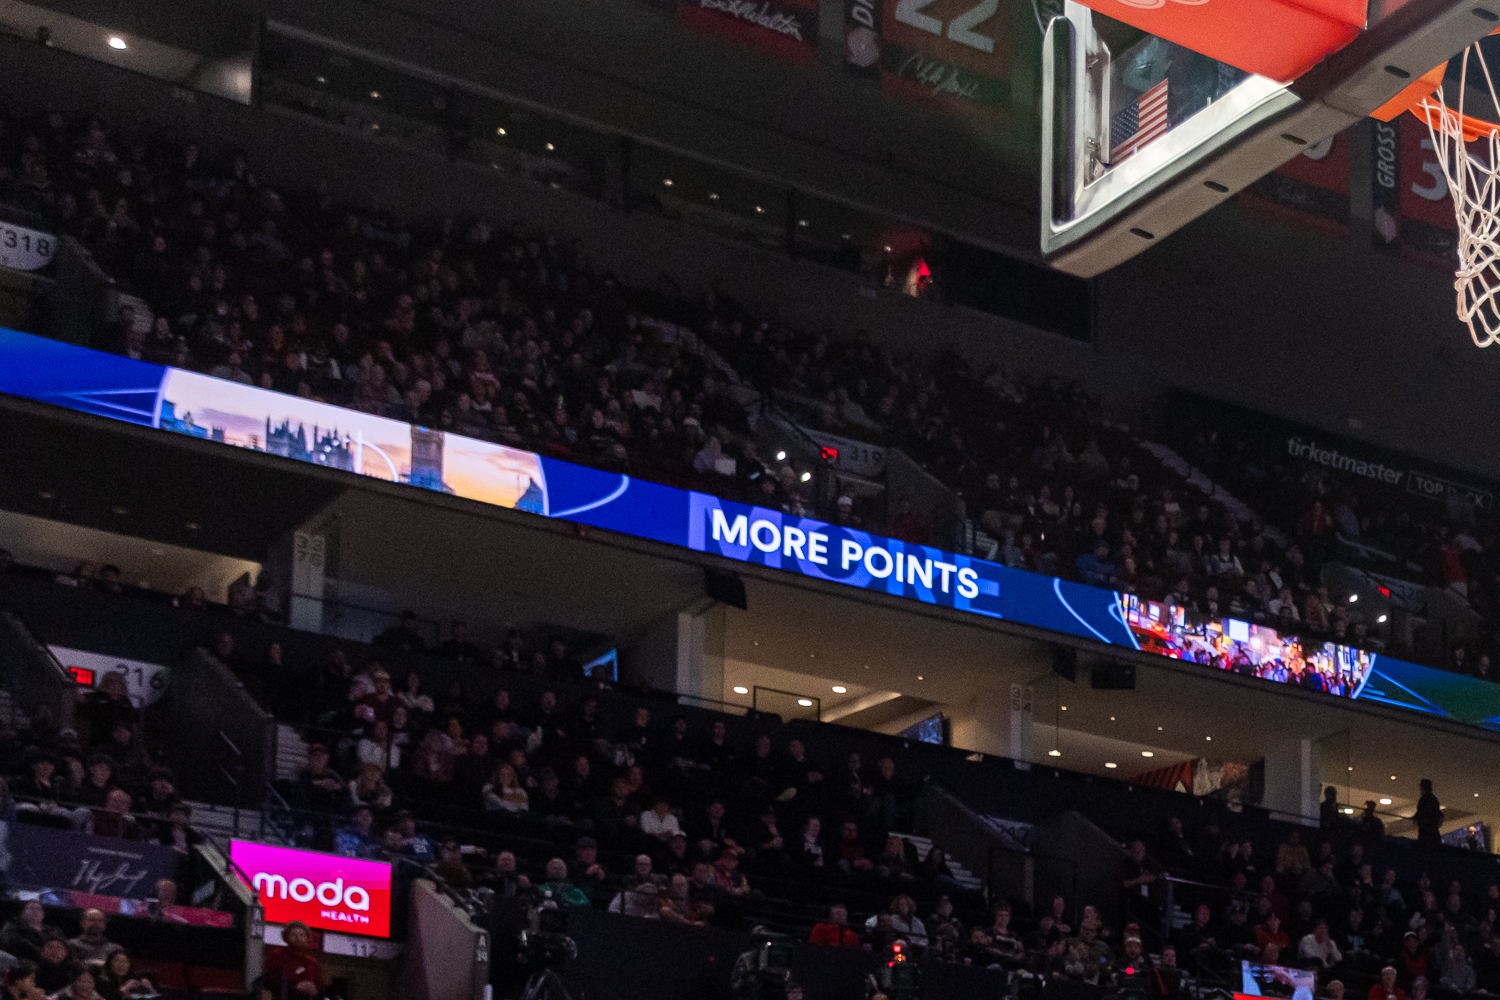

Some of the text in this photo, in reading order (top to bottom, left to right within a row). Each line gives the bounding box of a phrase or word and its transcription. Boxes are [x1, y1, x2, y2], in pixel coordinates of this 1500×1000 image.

[1377, 122, 1396, 189] GROSS
[5, 230, 50, 256] 318
[1288, 437, 1403, 485] ticketmaster
[1415, 476, 1443, 495] TOP
[712, 509, 979, 599] MORE POINTS
[253, 872, 370, 911] moda
[320, 909, 370, 925] HEALTH
